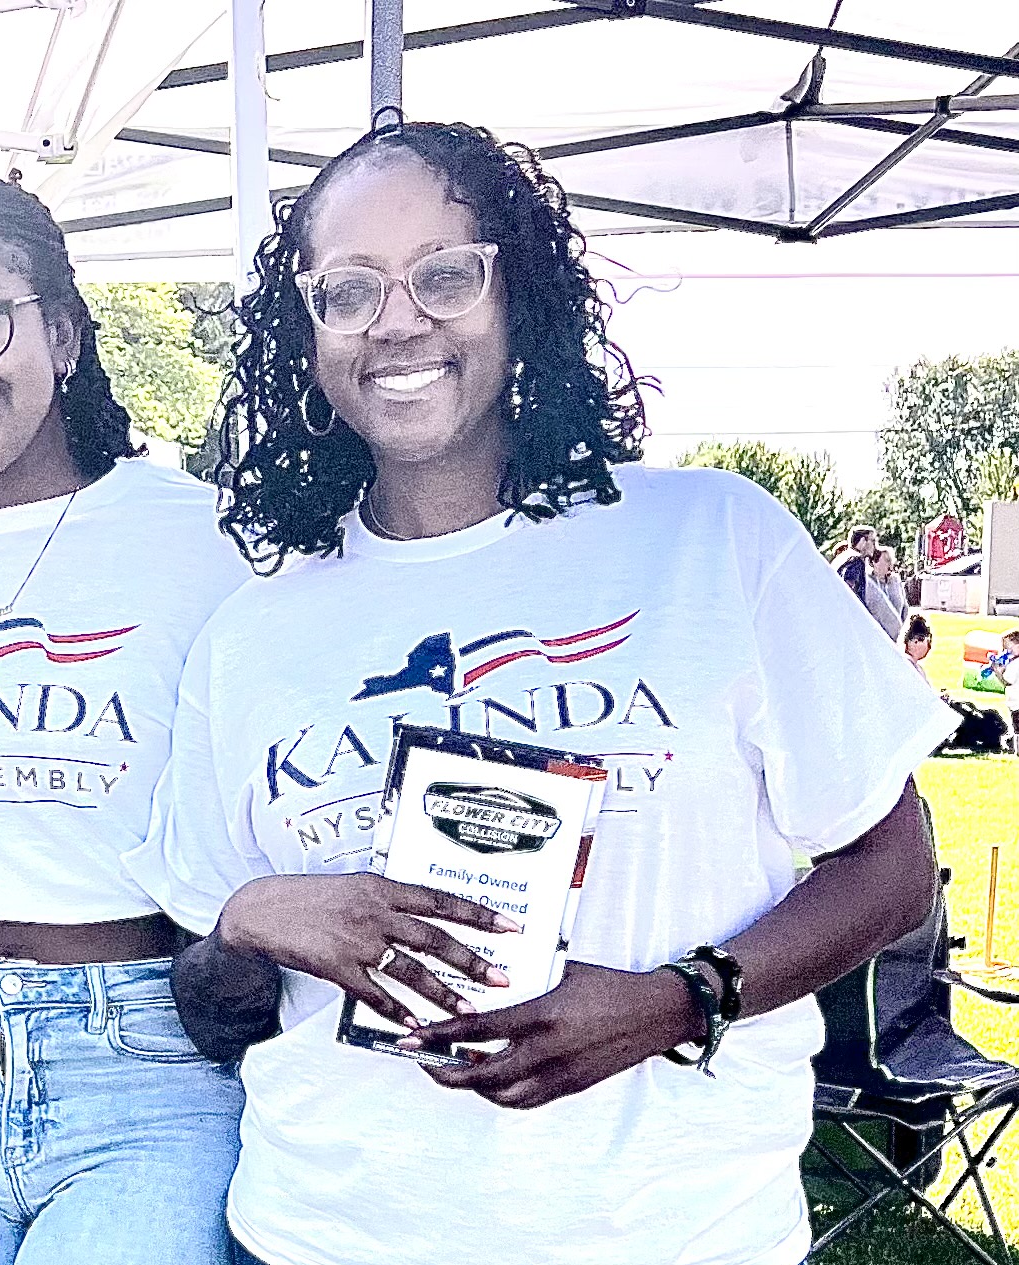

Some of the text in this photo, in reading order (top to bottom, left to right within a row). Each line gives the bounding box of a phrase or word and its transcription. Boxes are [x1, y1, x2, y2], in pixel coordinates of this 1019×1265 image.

[297, 806, 375, 851] NYS
[430, 799, 557, 833] FLOWER CITY
[429, 863, 529, 892] Family-Owned
